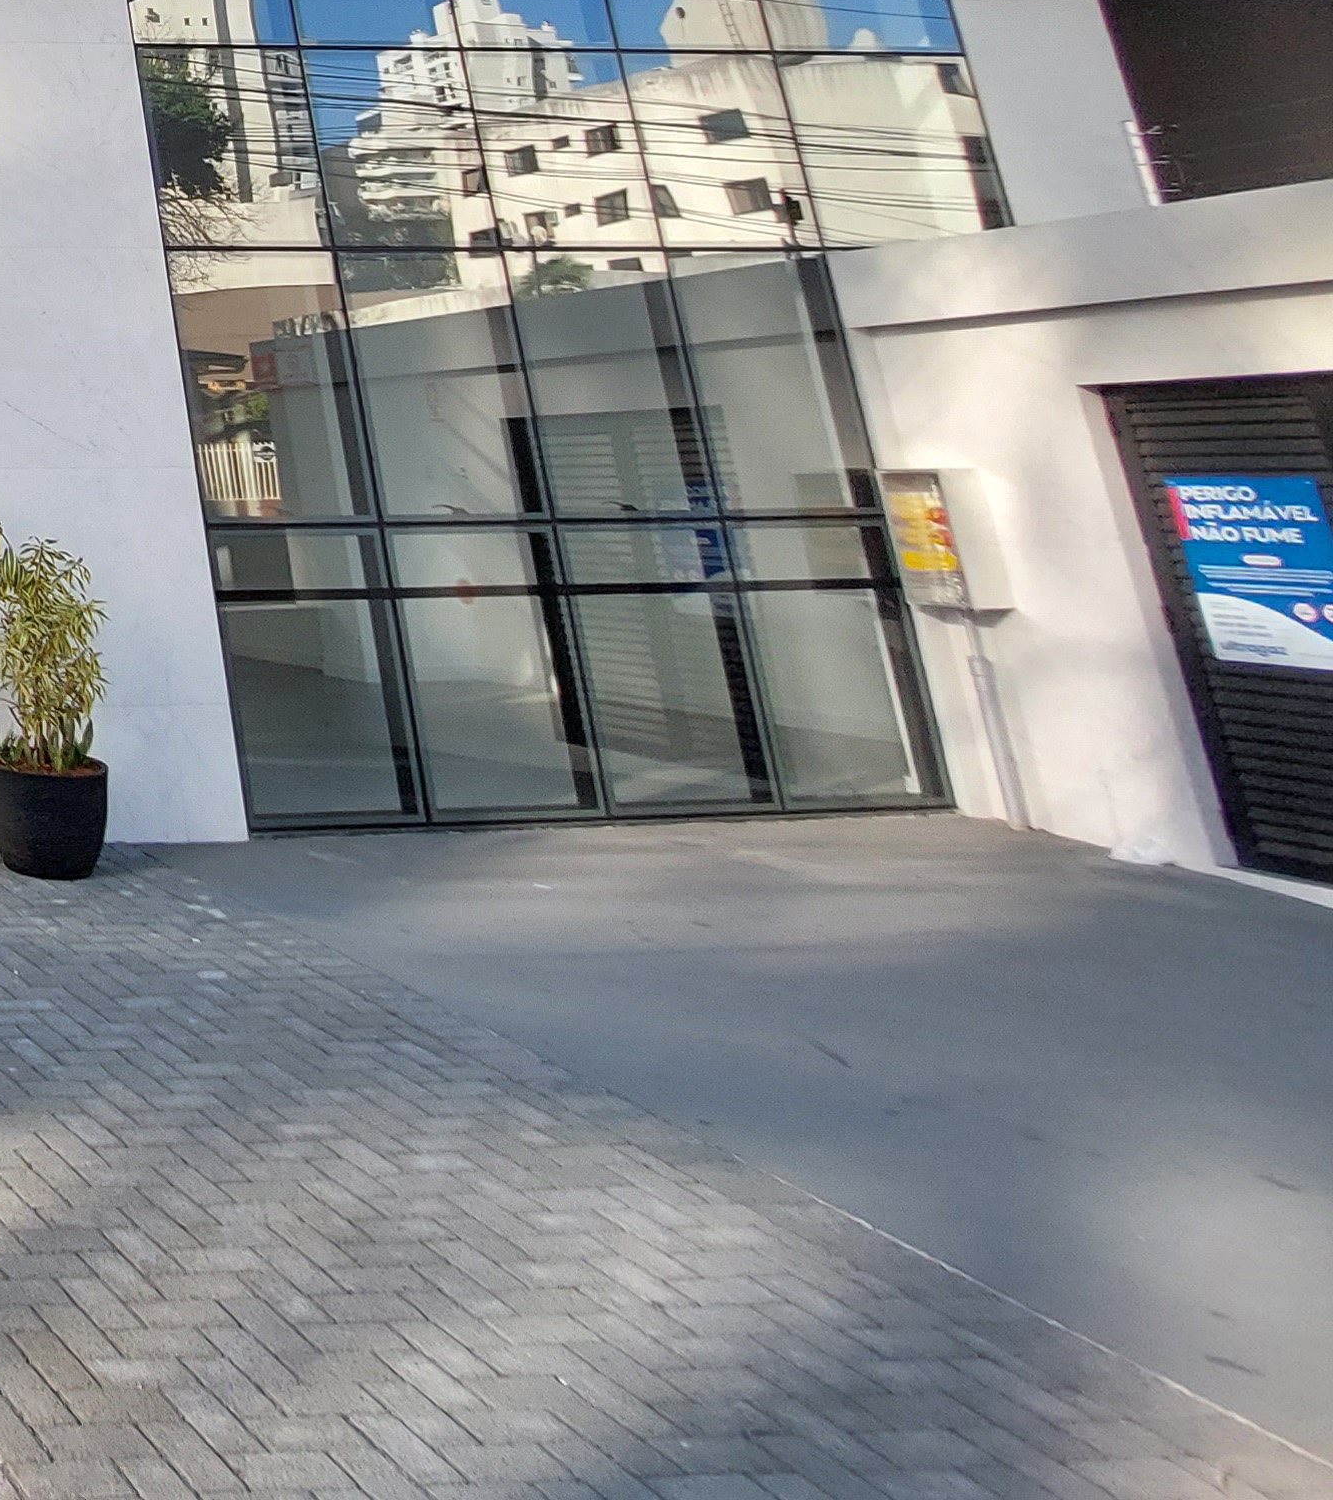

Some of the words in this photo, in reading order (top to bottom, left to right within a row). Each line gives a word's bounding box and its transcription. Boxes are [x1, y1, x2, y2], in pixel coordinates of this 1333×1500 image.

[1179, 485, 1257, 501] PERIGO
[1183, 500, 1320, 521] INFLAMÁVEL
[1190, 521, 1240, 542] NÃO
[1242, 526, 1305, 544] FUME
